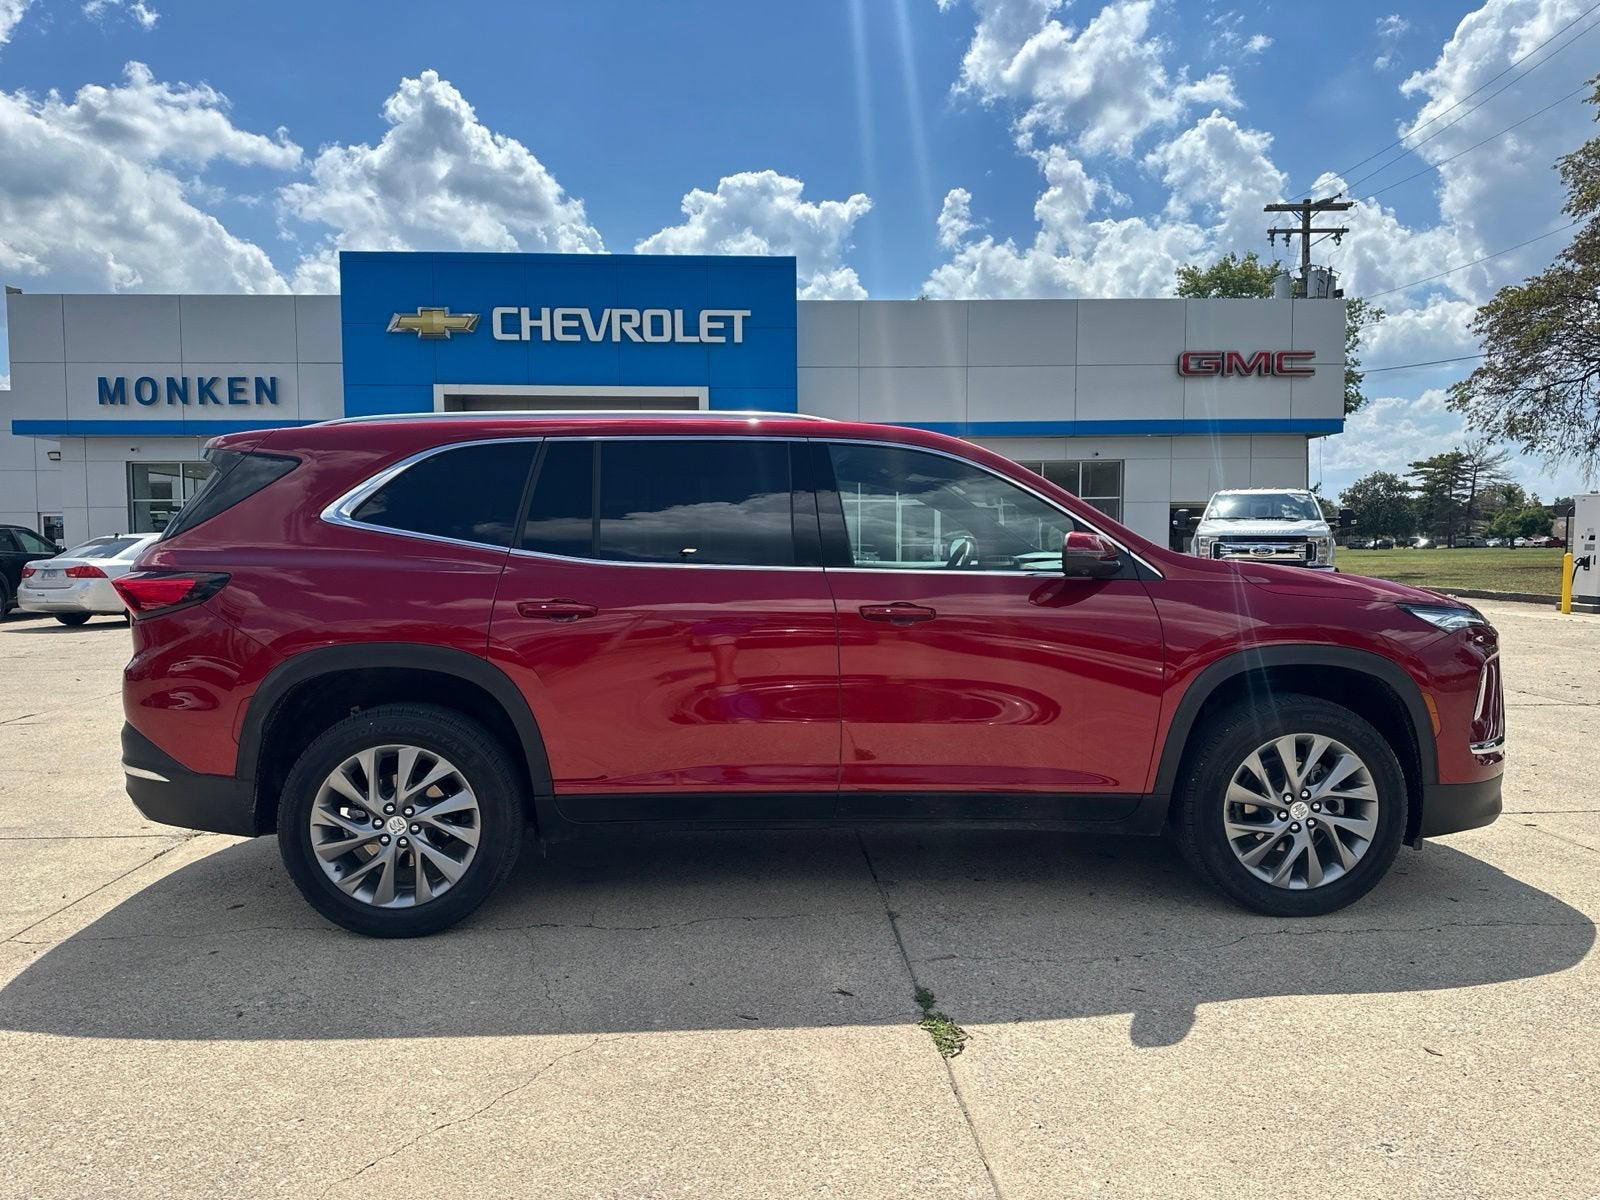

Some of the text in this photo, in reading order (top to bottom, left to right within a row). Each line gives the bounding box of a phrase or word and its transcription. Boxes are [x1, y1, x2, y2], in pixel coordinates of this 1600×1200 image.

[492, 307, 751, 343] CHEVROLET
[1178, 351, 1315, 377] GMC
[97, 376, 278, 405] MONKEN
